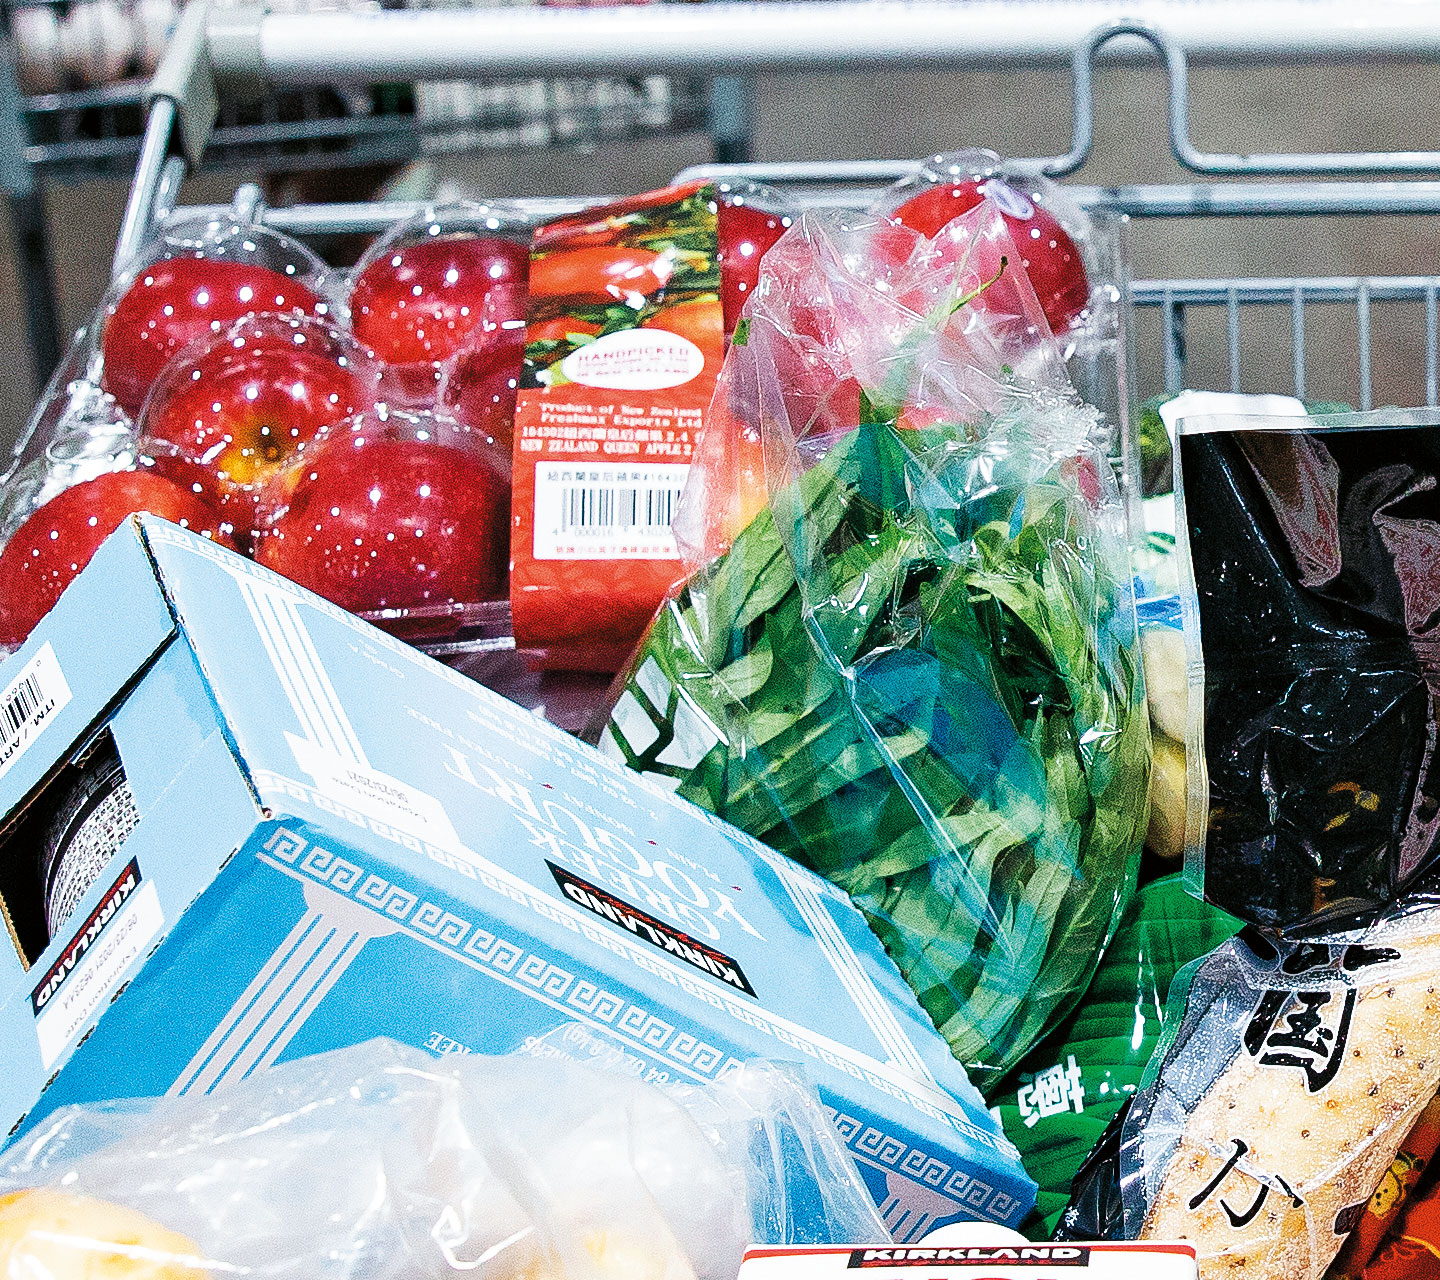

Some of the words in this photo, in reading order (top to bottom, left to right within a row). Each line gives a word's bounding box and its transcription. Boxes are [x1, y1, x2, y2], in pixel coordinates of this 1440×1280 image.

[613, 414, 670, 427] Exports
[678, 416, 703, 428] Ltd
[520, 439, 543, 452] NEW
[548, 440, 599, 453] ZEALAND
[603, 442, 641, 454] QUEEN
[646, 443, 681, 455] APPLE
[30, 698, 55, 727] ITM.
[442, 741, 765, 941] YOGURT
[513, 814, 718, 939] GREEK
[36, 872, 136, 1009] KIRKLAND
[564, 878, 744, 989] KIRKLAND
[87, 945, 137, 1008] Expiration
[63, 1007, 87, 1039] Date
[424, 1031, 470, 1054] REE
[862, 1248, 1081, 1263] KIRKLAND
